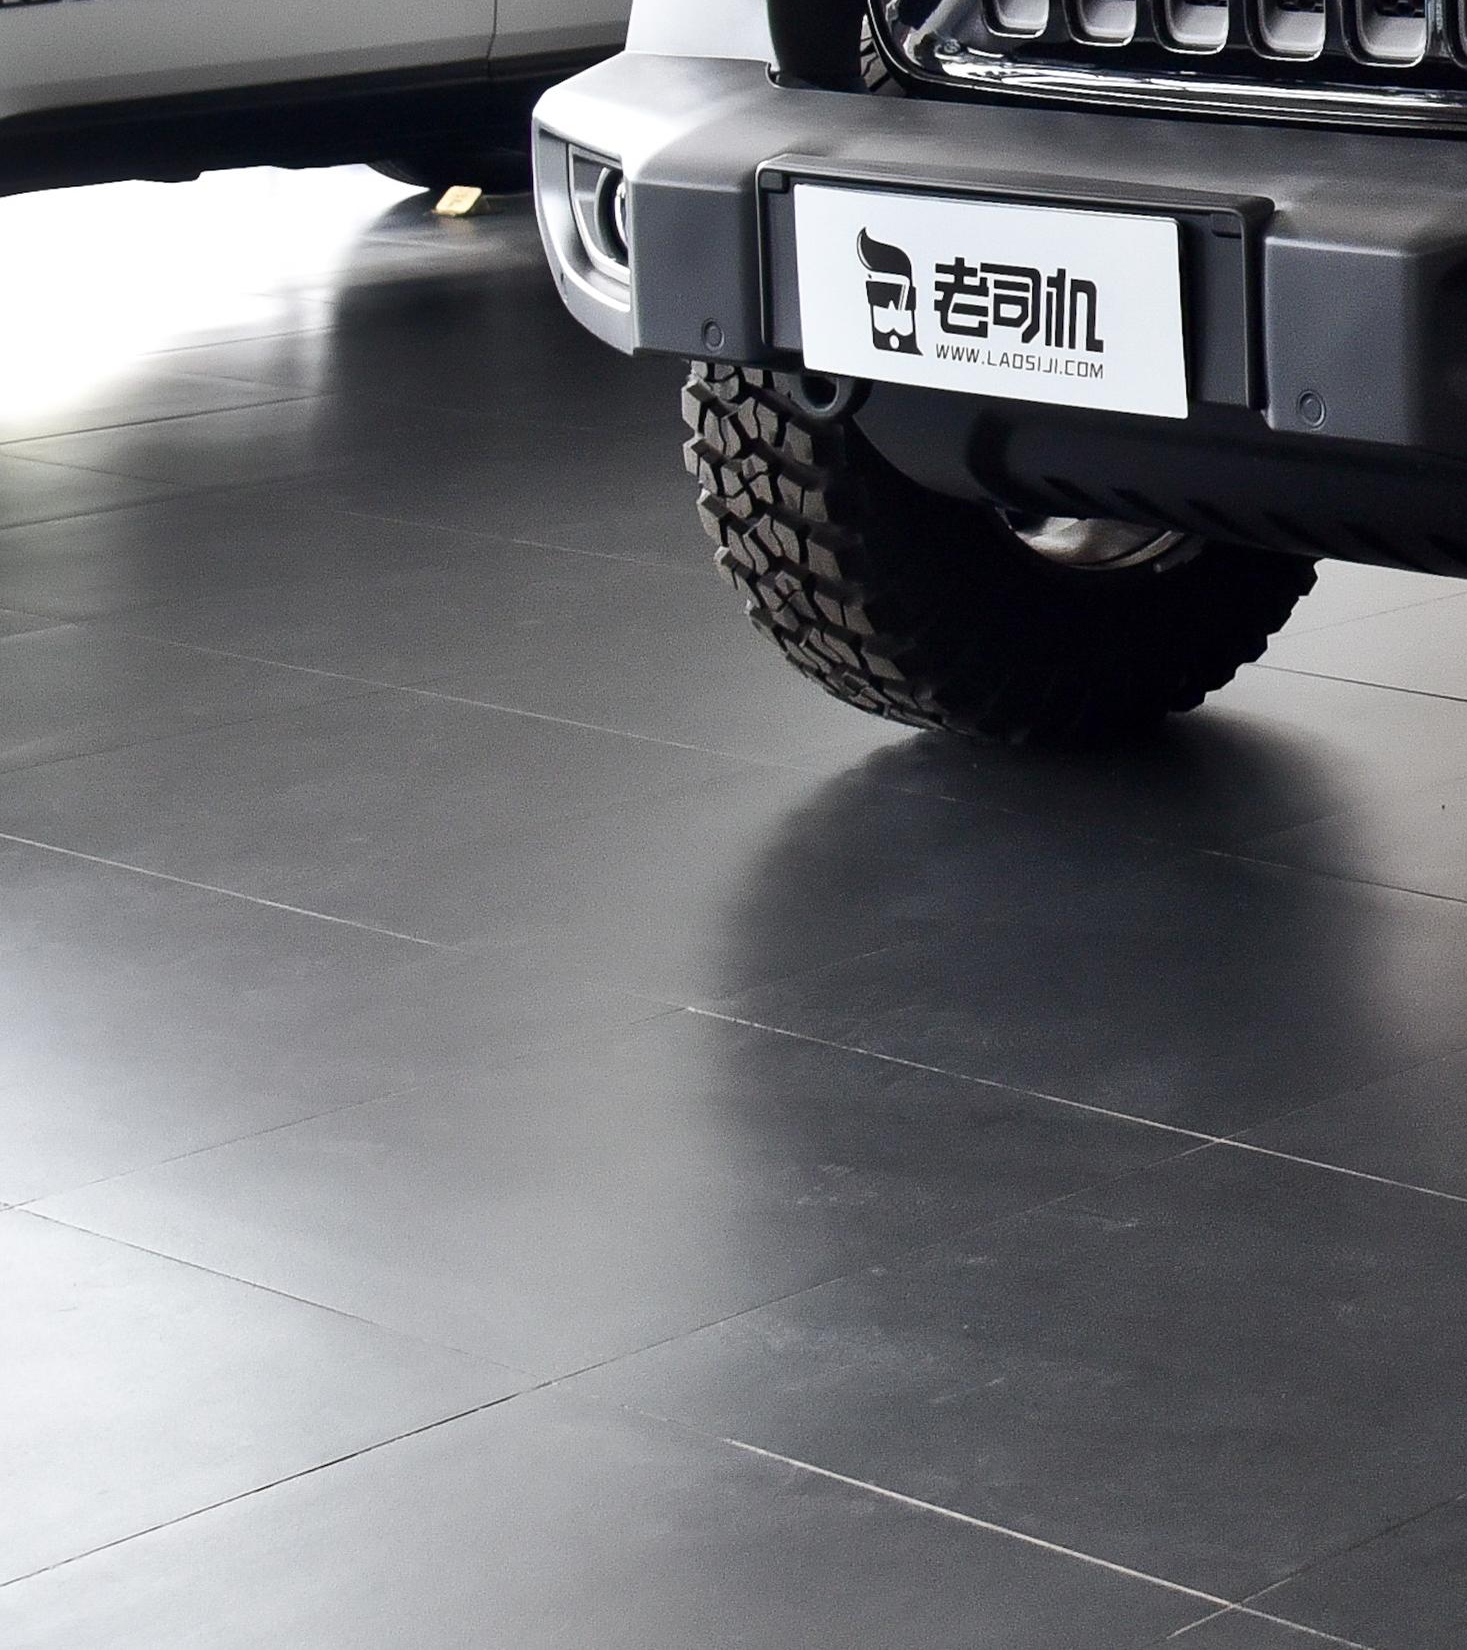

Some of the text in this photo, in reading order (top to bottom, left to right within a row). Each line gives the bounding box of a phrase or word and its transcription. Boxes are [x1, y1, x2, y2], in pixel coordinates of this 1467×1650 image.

[934, 256, 1104, 352] 老司机
[936, 343, 1104, 379] WWW.LAOSIJI.COM
